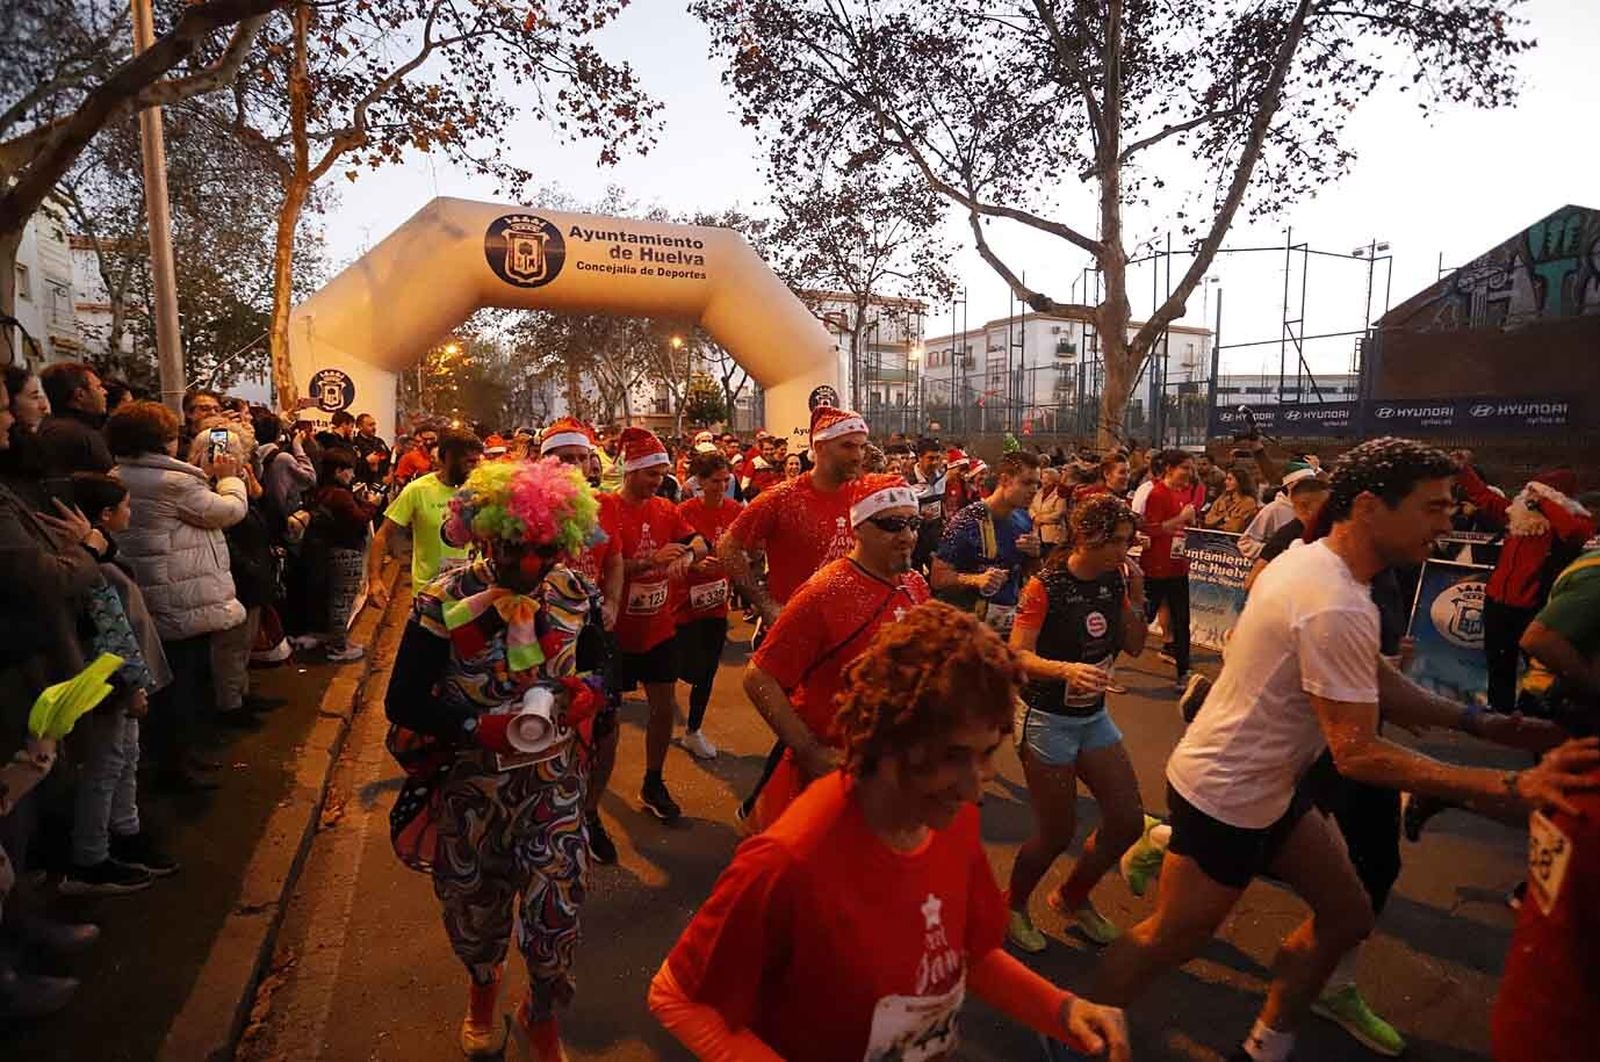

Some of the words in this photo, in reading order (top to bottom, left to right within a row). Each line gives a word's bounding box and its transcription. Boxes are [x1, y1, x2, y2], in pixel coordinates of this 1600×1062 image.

[569, 226, 703, 249] Ayuntamiento
[609, 245, 633, 260] de
[640, 247, 704, 266] Huelva
[640, 266, 654, 276] de
[657, 267, 707, 279] Deportes
[1303, 410, 1349, 420] HYUNDAI
[1397, 407, 1454, 418] HYUNDAI
[1498, 403, 1568, 416] HYUNDAI
[1235, 412, 1275, 421] HYNDAI
[1190, 560, 1206, 572] de
[1209, 562, 1248, 579] Huelv
